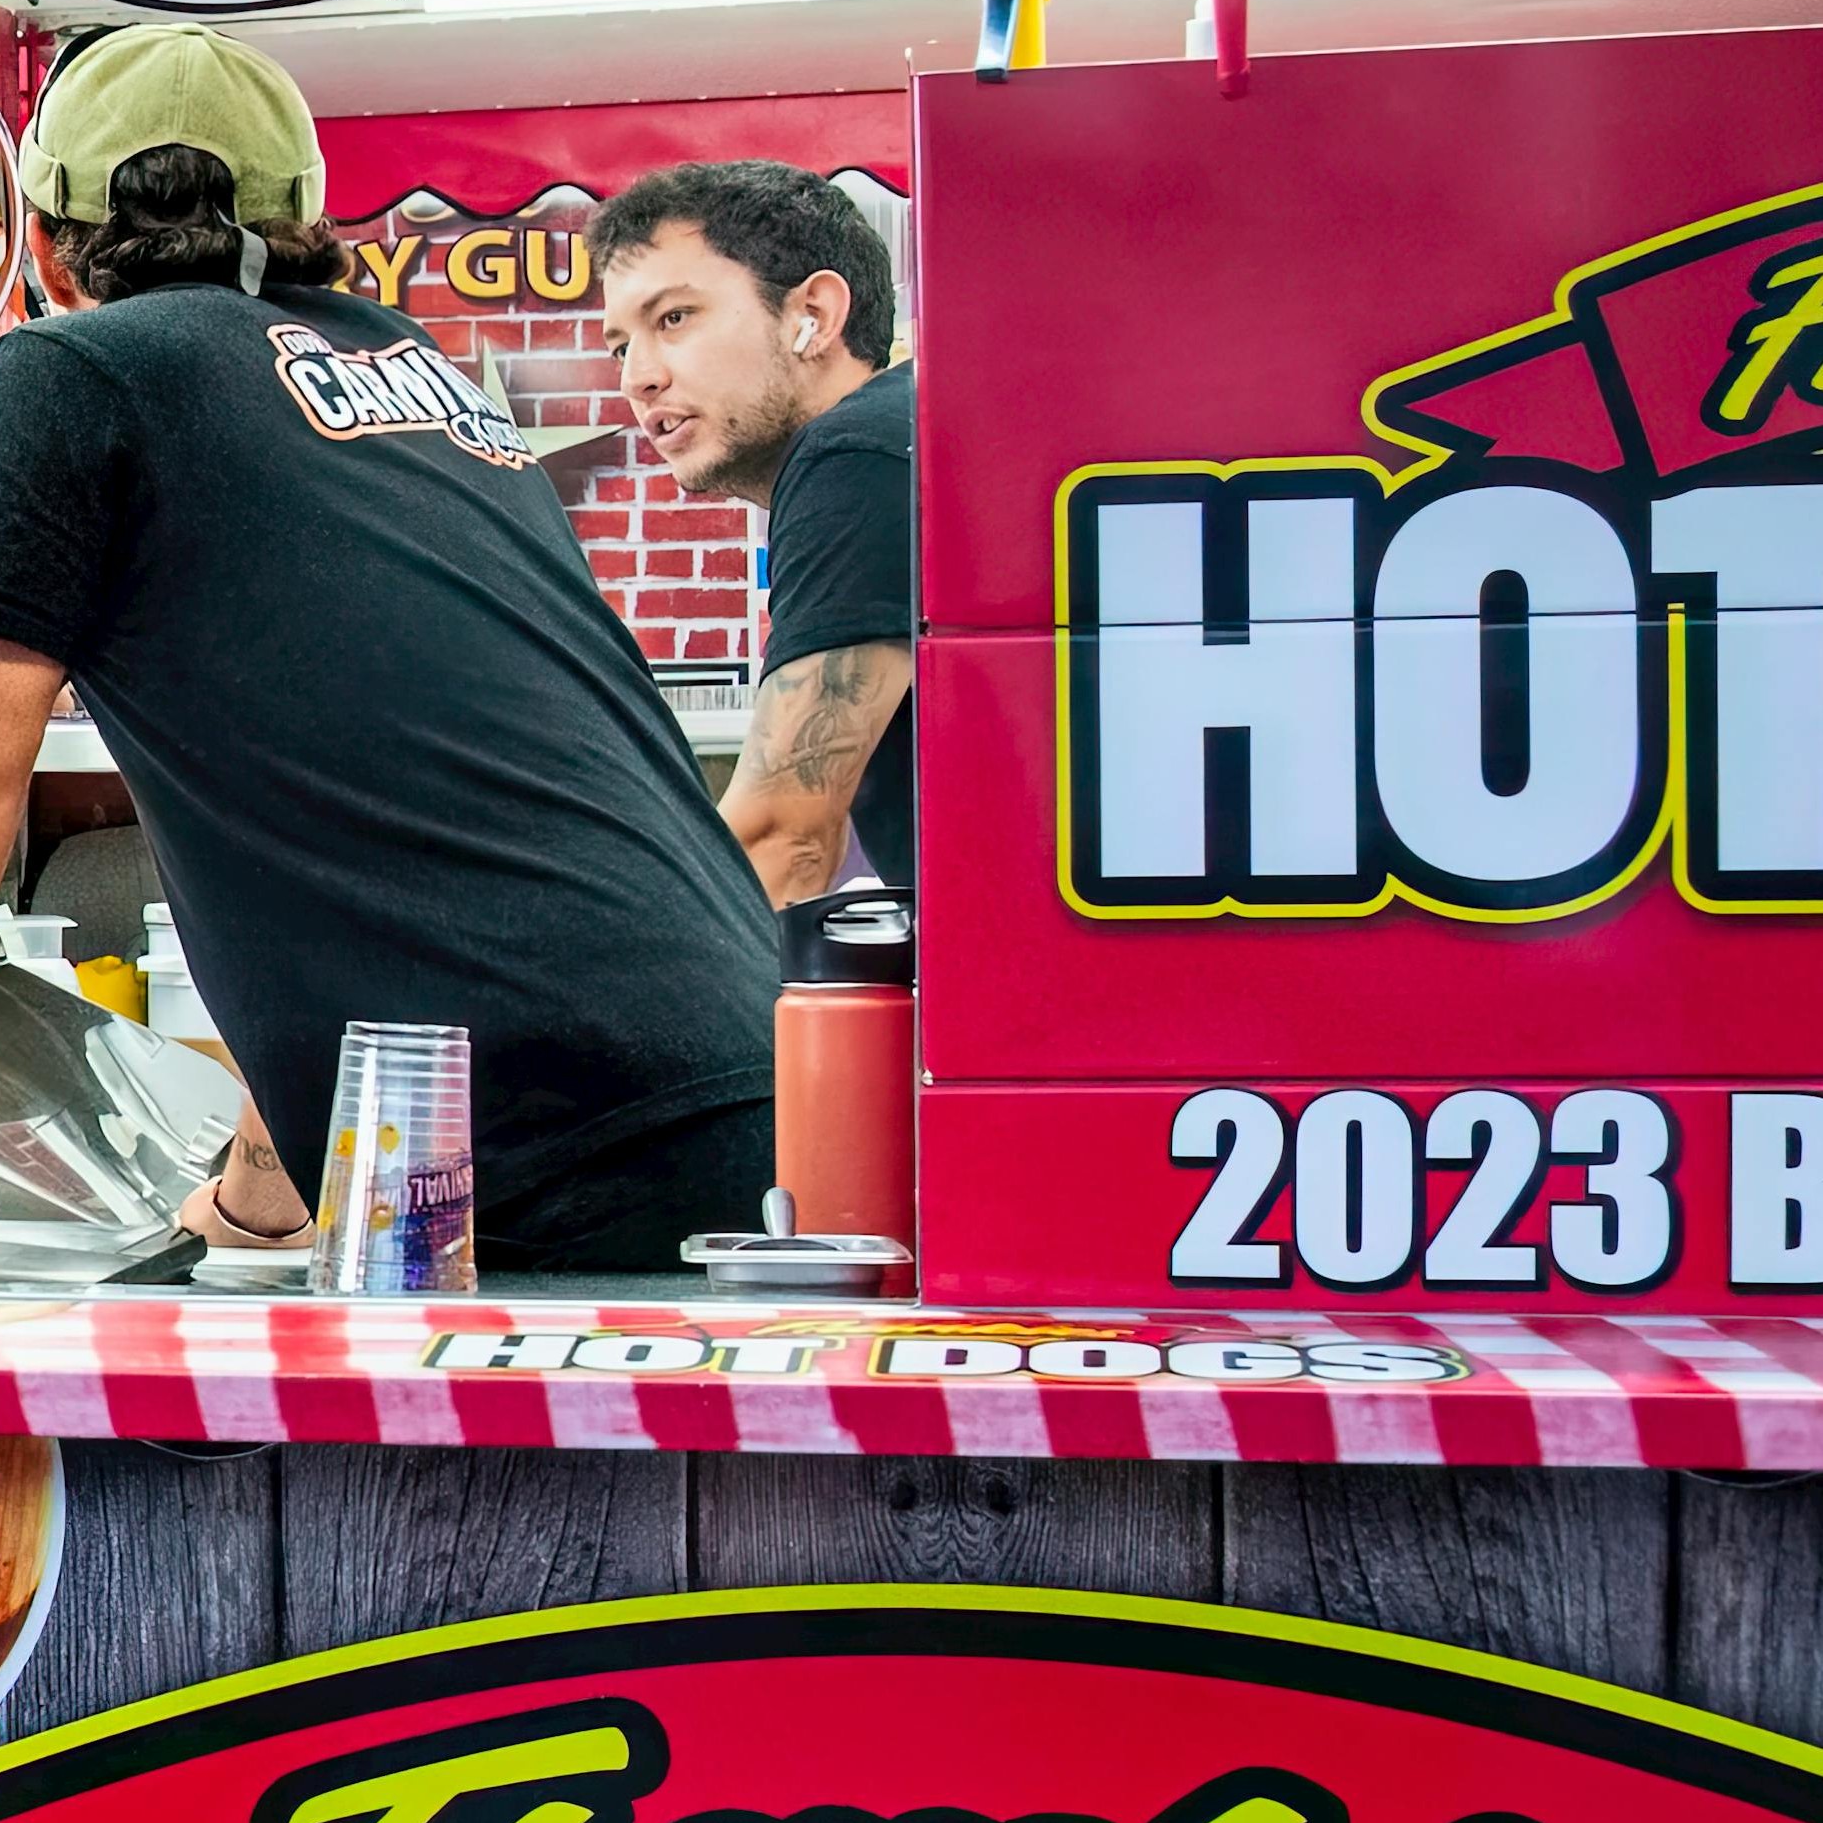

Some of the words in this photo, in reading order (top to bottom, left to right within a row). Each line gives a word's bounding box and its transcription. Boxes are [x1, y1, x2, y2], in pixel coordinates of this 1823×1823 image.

[1169, 1087, 1682, 1291] 2023
[433, 1333, 826, 1374] HOT
[886, 1340, 1455, 1380] DOGS
